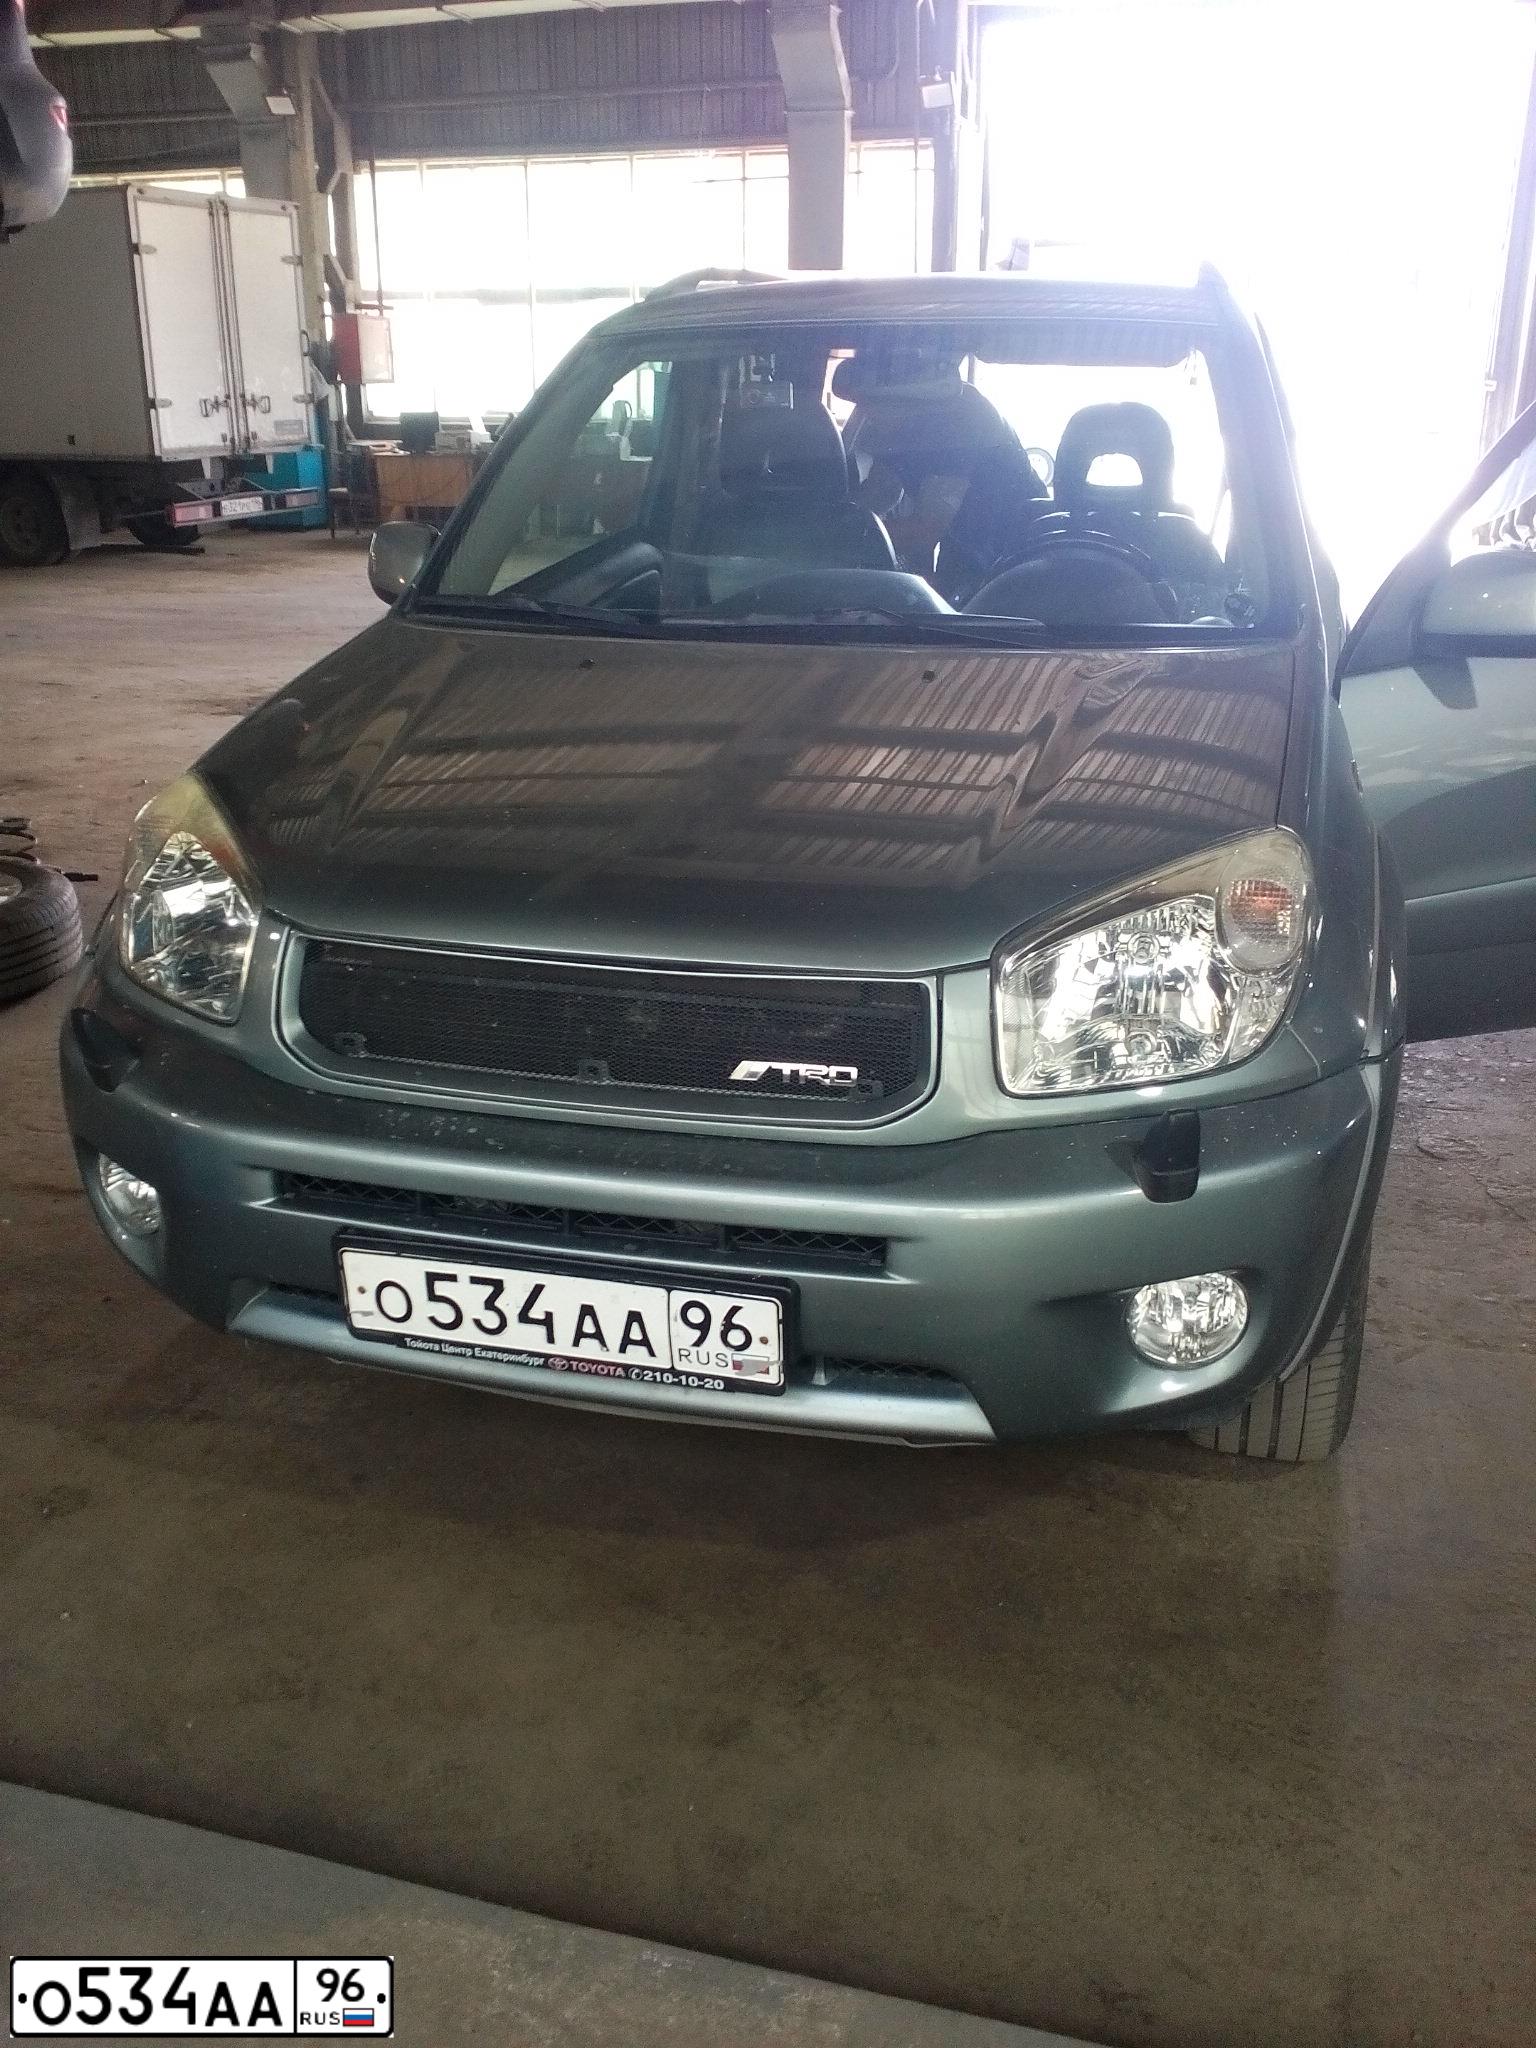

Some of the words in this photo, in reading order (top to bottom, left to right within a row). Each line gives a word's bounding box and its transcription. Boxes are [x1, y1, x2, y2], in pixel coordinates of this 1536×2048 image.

[770, 1062, 858, 1088] TRD
[679, 1299, 753, 1352] 96
[405, 1338, 440, 1352] Тойота
[441, 1343, 472, 1357] Центр
[475, 1348, 545, 1367] Екатеринбург
[571, 1362, 625, 1377] TOYOTA
[643, 1370, 725, 1391] 210-10-20
[678, 1348, 729, 1368] RUS
